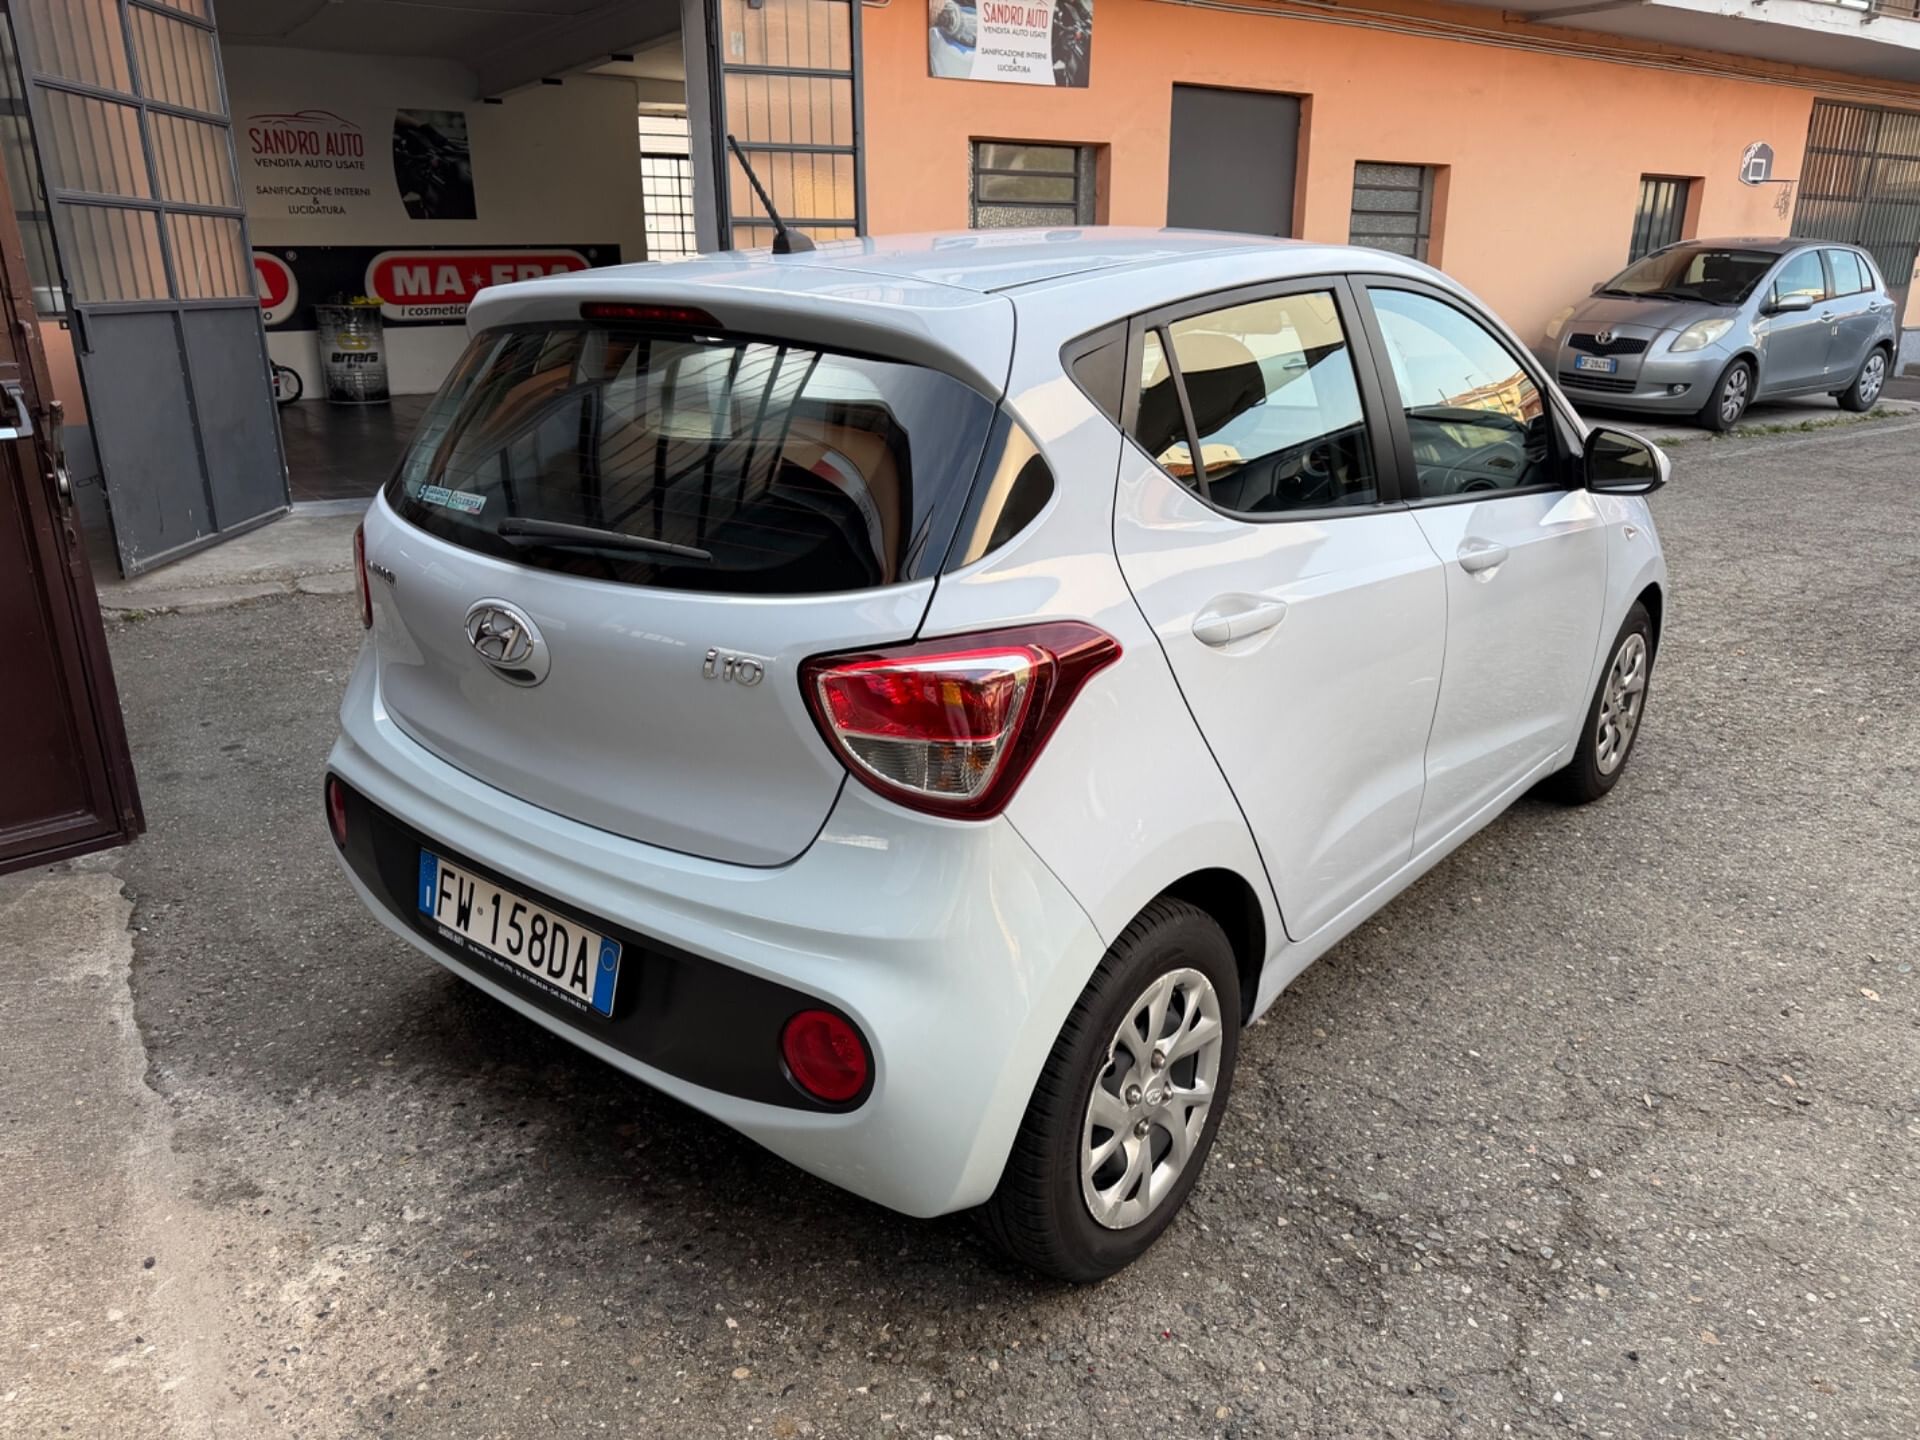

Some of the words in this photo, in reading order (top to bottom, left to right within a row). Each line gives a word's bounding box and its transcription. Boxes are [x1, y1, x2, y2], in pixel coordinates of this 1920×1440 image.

[983, 2, 1024, 26] SANDRO
[1026, 8, 1048, 29] AUTO
[983, 26, 1010, 35] VENDITA
[1012, 28, 1029, 36] AUTO
[981, 47, 1024, 58] SANIFICAZIONE
[1026, 52, 1047, 60] INTERNI
[997, 64, 1031, 73] LUCIDATURA
[249, 128, 320, 156] SANDRO
[326, 132, 364, 157] AUTO
[254, 158, 301, 168] VENDITA
[304, 159, 333, 169] AUTO
[335, 160, 365, 170] USATE
[256, 185, 332, 196] SANIFICAZIONE
[334, 187, 371, 197] INTERNI
[288, 205, 346, 215] LUCIDATURA
[408, 304, 467, 316] cosmetici
[437, 867, 475, 933] FW
[490, 893, 588, 995] 158DA
